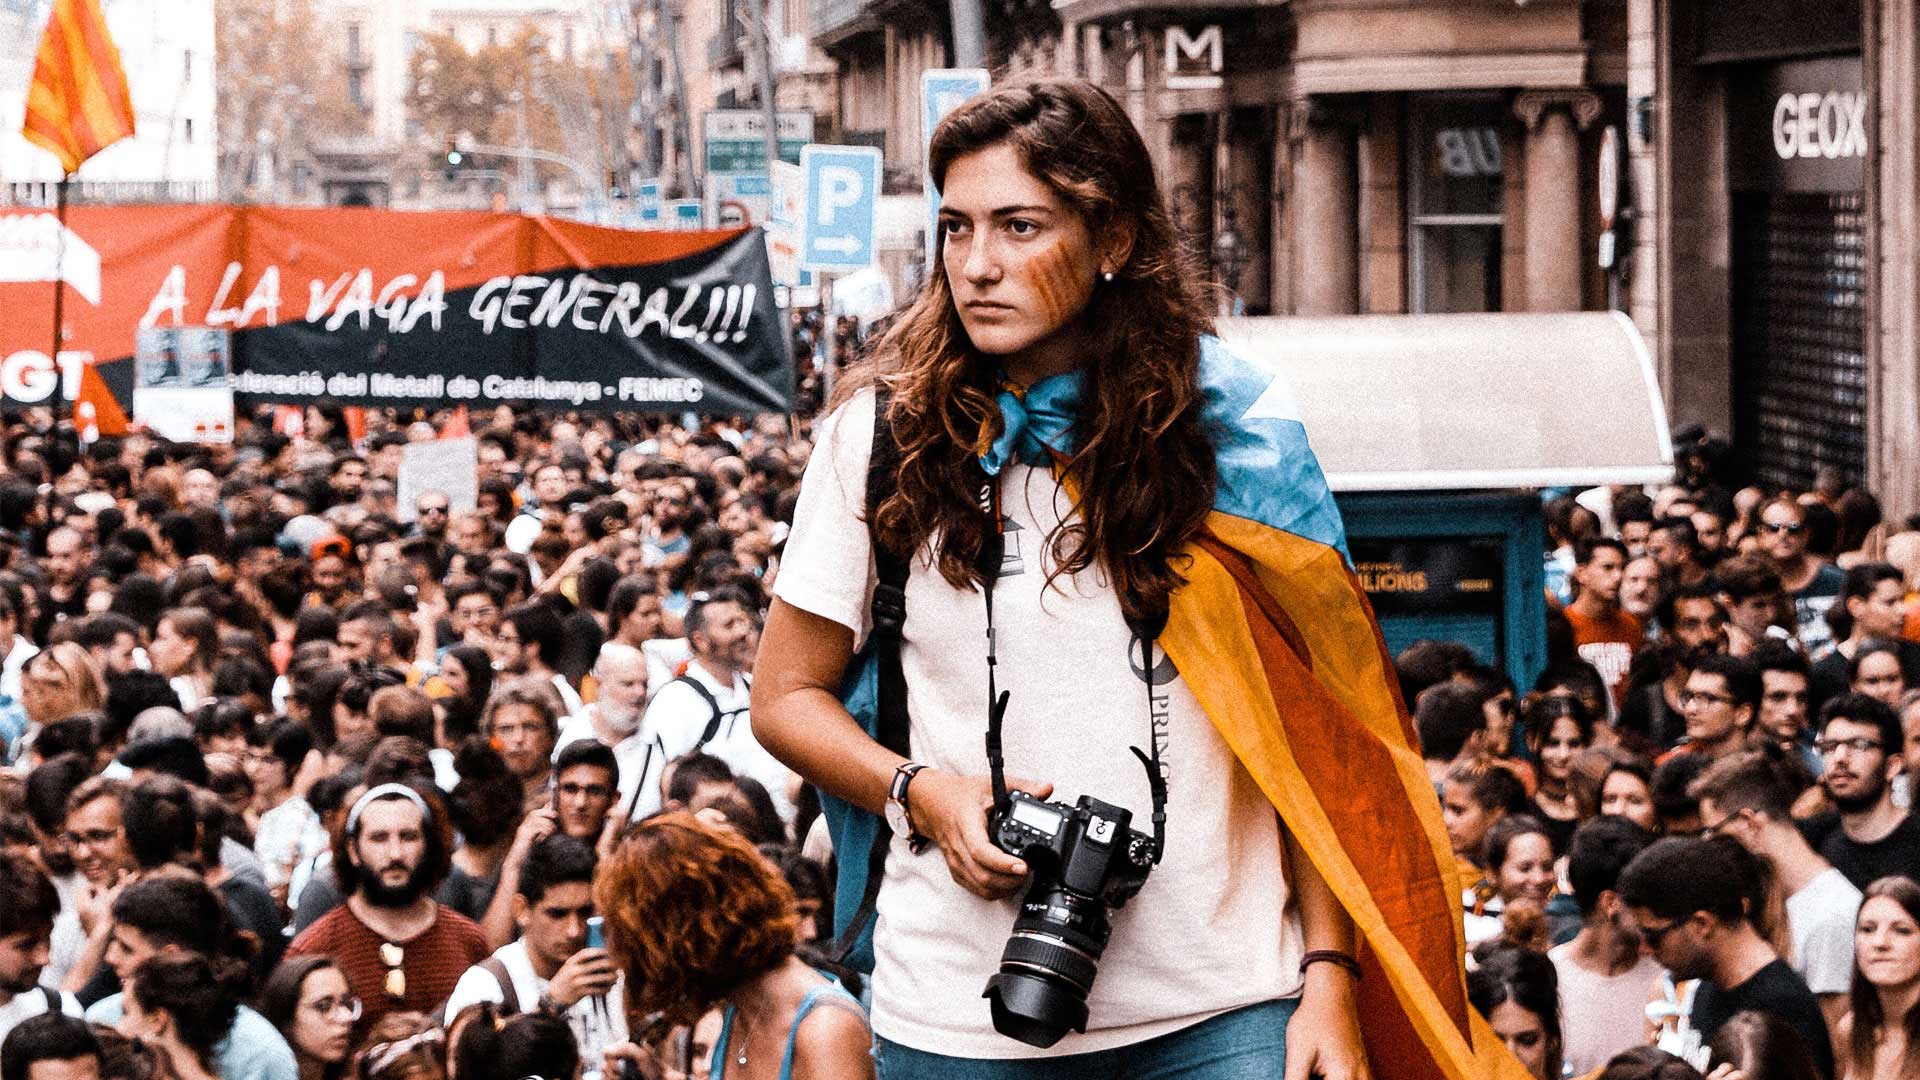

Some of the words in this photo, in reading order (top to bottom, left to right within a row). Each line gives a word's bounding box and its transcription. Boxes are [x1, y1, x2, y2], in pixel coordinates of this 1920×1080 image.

[1165, 25, 1223, 72] M
[1773, 91, 1868, 160] GEOX
[819, 165, 864, 225] P
[140, 265, 189, 327] A
[205, 261, 281, 328] LA
[305, 268, 449, 334] VAGA
[469, 273, 757, 344] GENERAL!!!
[0, 350, 95, 403] GT
[225, 369, 326, 396] ederació
[327, 372, 368, 396] del
[370, 373, 445, 398] Metall
[446, 374, 480, 399] de
[482, 374, 602, 405] Catalunya
[618, 377, 704, 402] FEMEC
